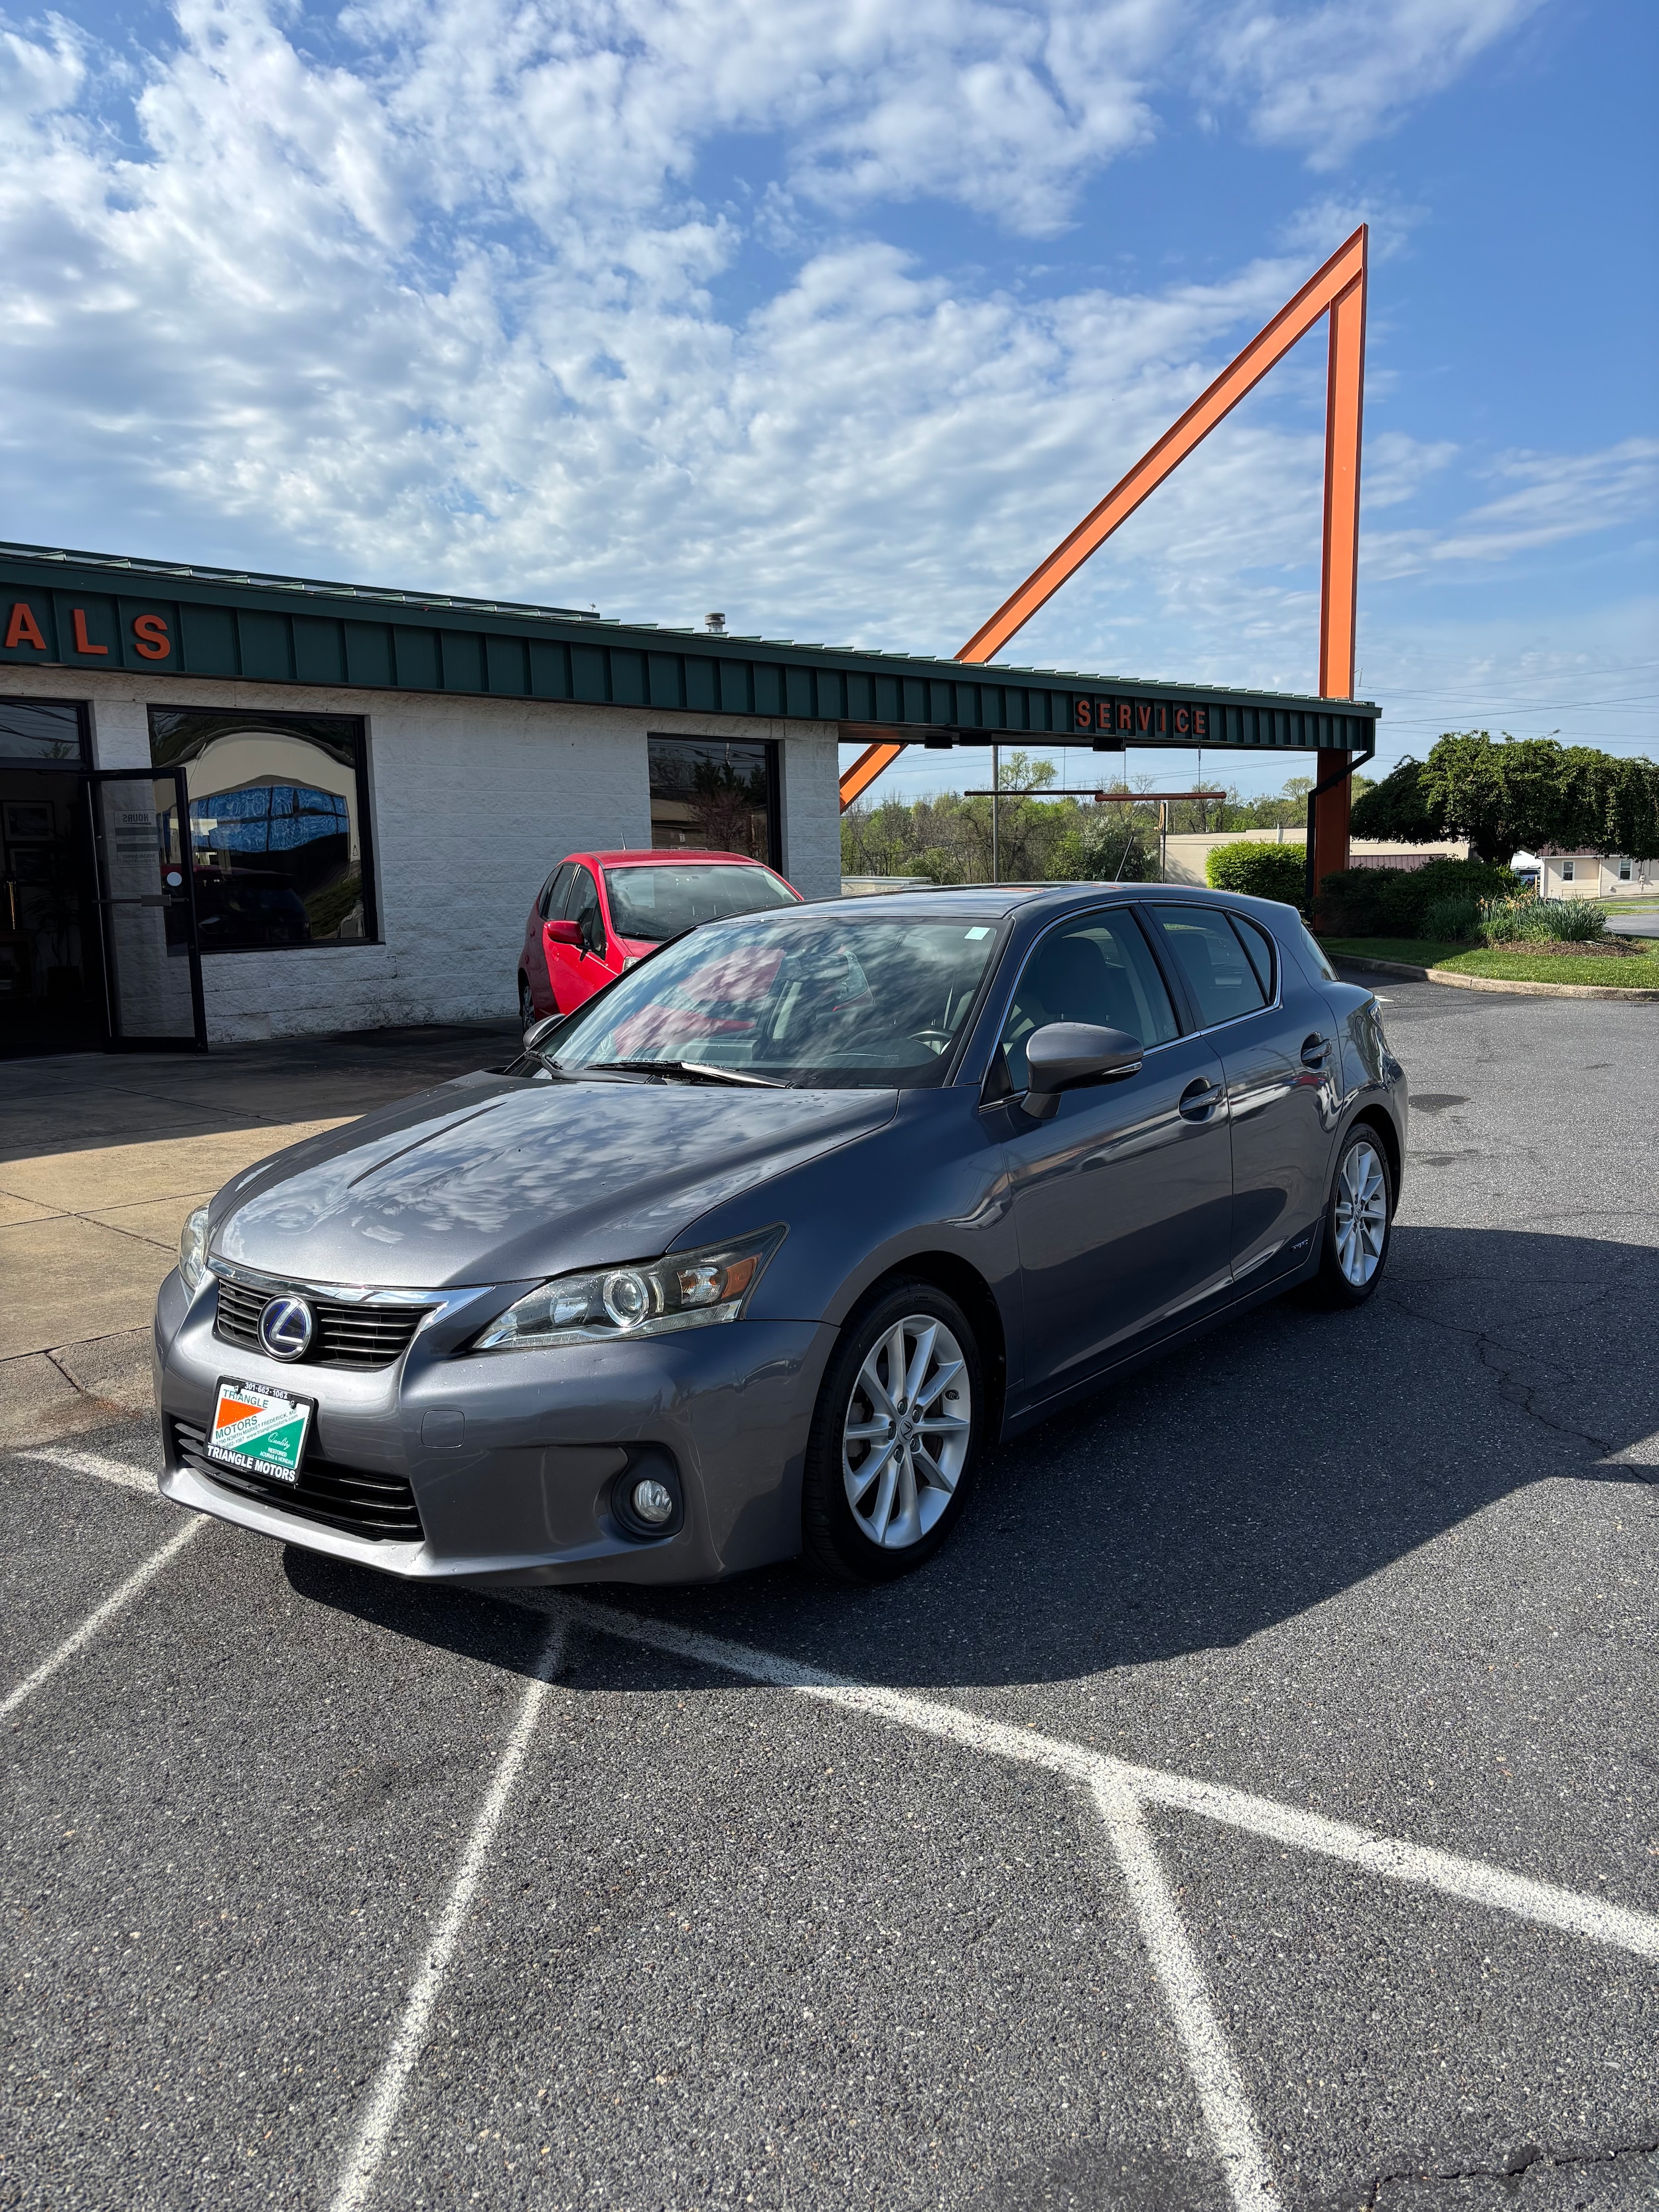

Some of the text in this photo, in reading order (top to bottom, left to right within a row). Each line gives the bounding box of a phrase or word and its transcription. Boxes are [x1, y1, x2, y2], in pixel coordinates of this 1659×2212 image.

[5, 603, 171, 660] ALS
[1077, 700, 1206, 734] SERVICE
[223, 1389, 269, 1408] TRIANGLE
[216, 1416, 257, 1439] MOTORS
[227, 1433, 242, 1441] NORTH
[243, 1424, 261, 1434] MARKET
[261, 1413, 288, 1427] FREDERICK,
[246, 1415, 298, 1439] www.trianglemotors.com
[267, 1447, 287, 1457] RESTORED
[268, 1432, 291, 1450] Quality
[207, 1445, 296, 1482] TRIANGLE MOTORS
[259, 1451, 275, 1459] ACURAS
[278, 1455, 294, 1465] HONDAS
